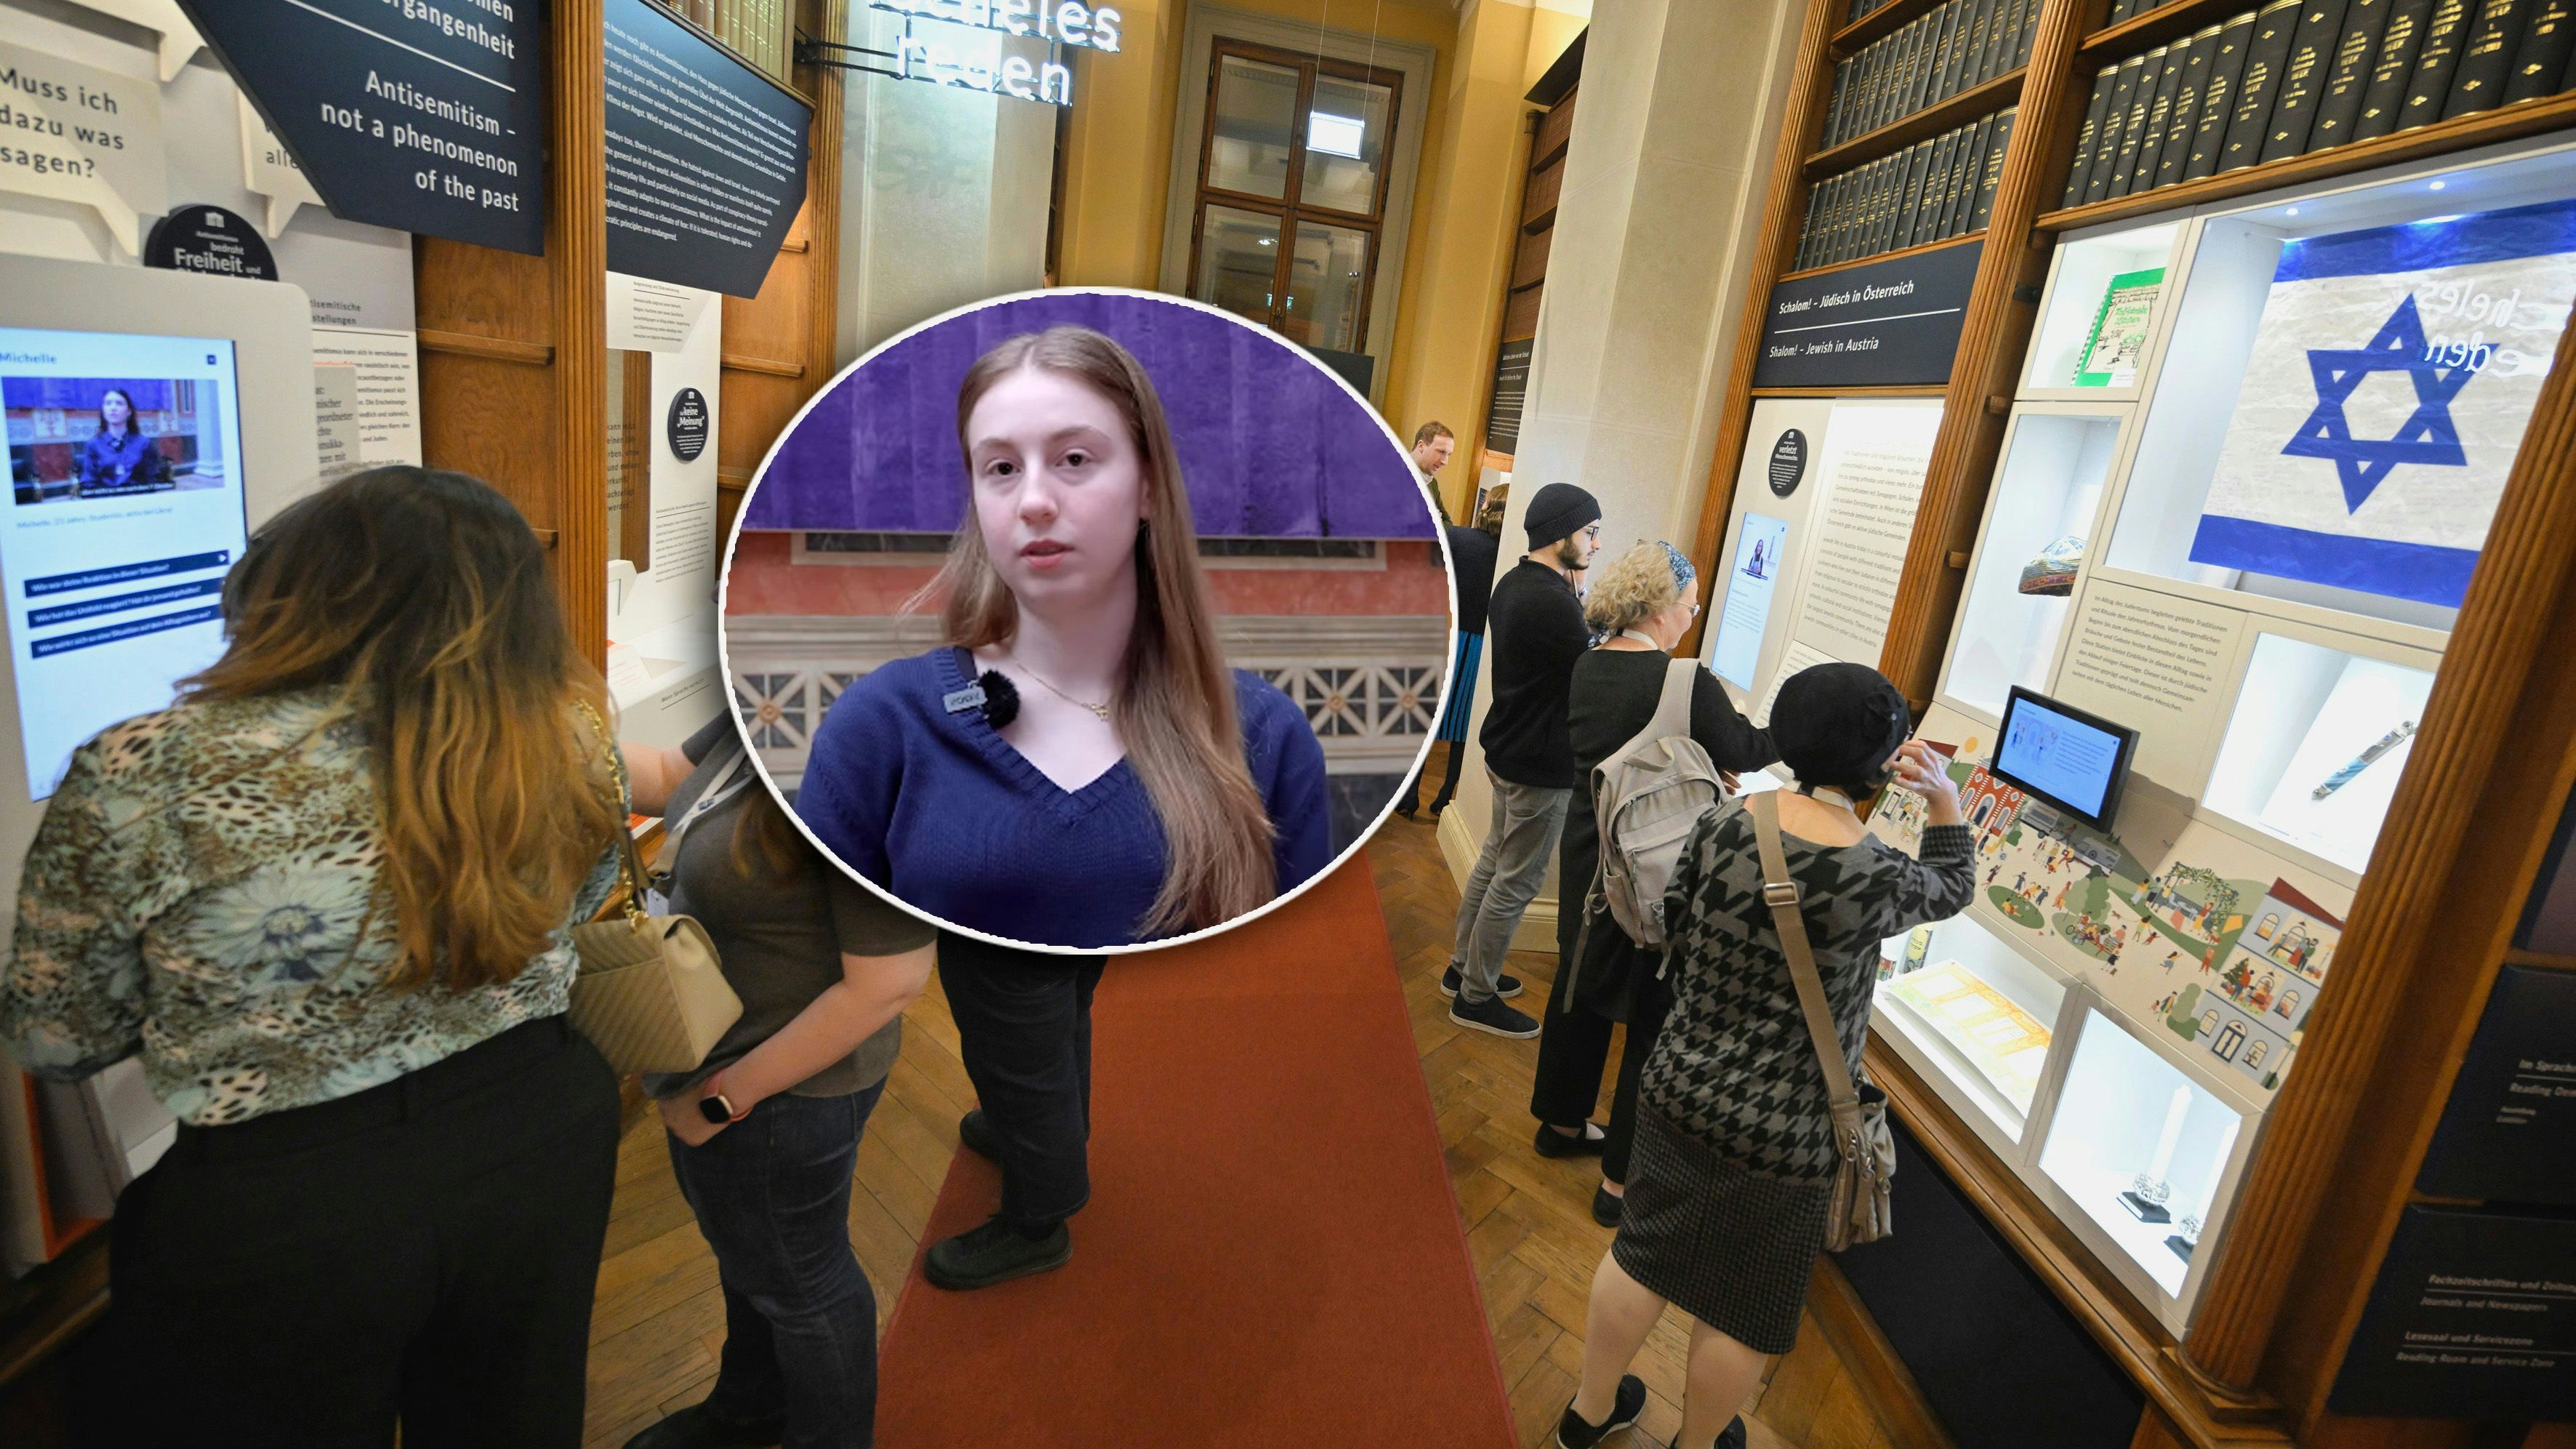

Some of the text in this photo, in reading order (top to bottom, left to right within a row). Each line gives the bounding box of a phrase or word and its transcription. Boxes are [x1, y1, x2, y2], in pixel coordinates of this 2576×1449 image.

[467, 0, 513, 23] men
[381, 0, 515, 60] gangenheit
[0, 68, 117, 115] Muss ich
[365, 70, 499, 136] Antisemitism
[0, 104, 124, 150] dazu was
[321, 103, 518, 177] not a phenomenon
[0, 146, 95, 178] sagen?
[415, 169, 519, 212] of the past
[174, 247, 244, 273] Freiheit
[245, 266, 261, 275] und
[210, 241, 244, 255] bedroht
[1779, 298, 1812, 314] Schalom!
[1819, 290, 1850, 308] Jüdisch
[1852, 290, 1861, 302] in
[1863, 279, 1914, 301] Österreich
[0, 353, 57, 364] Michelle
[1769, 345, 1798, 358] Shalom!
[1805, 340, 1833, 356] Jewish
[1835, 340, 1843, 352] in
[1845, 337, 1879, 352] Austria
[683, 406, 698, 415] keine
[1779, 445, 1797, 454] verletzt
